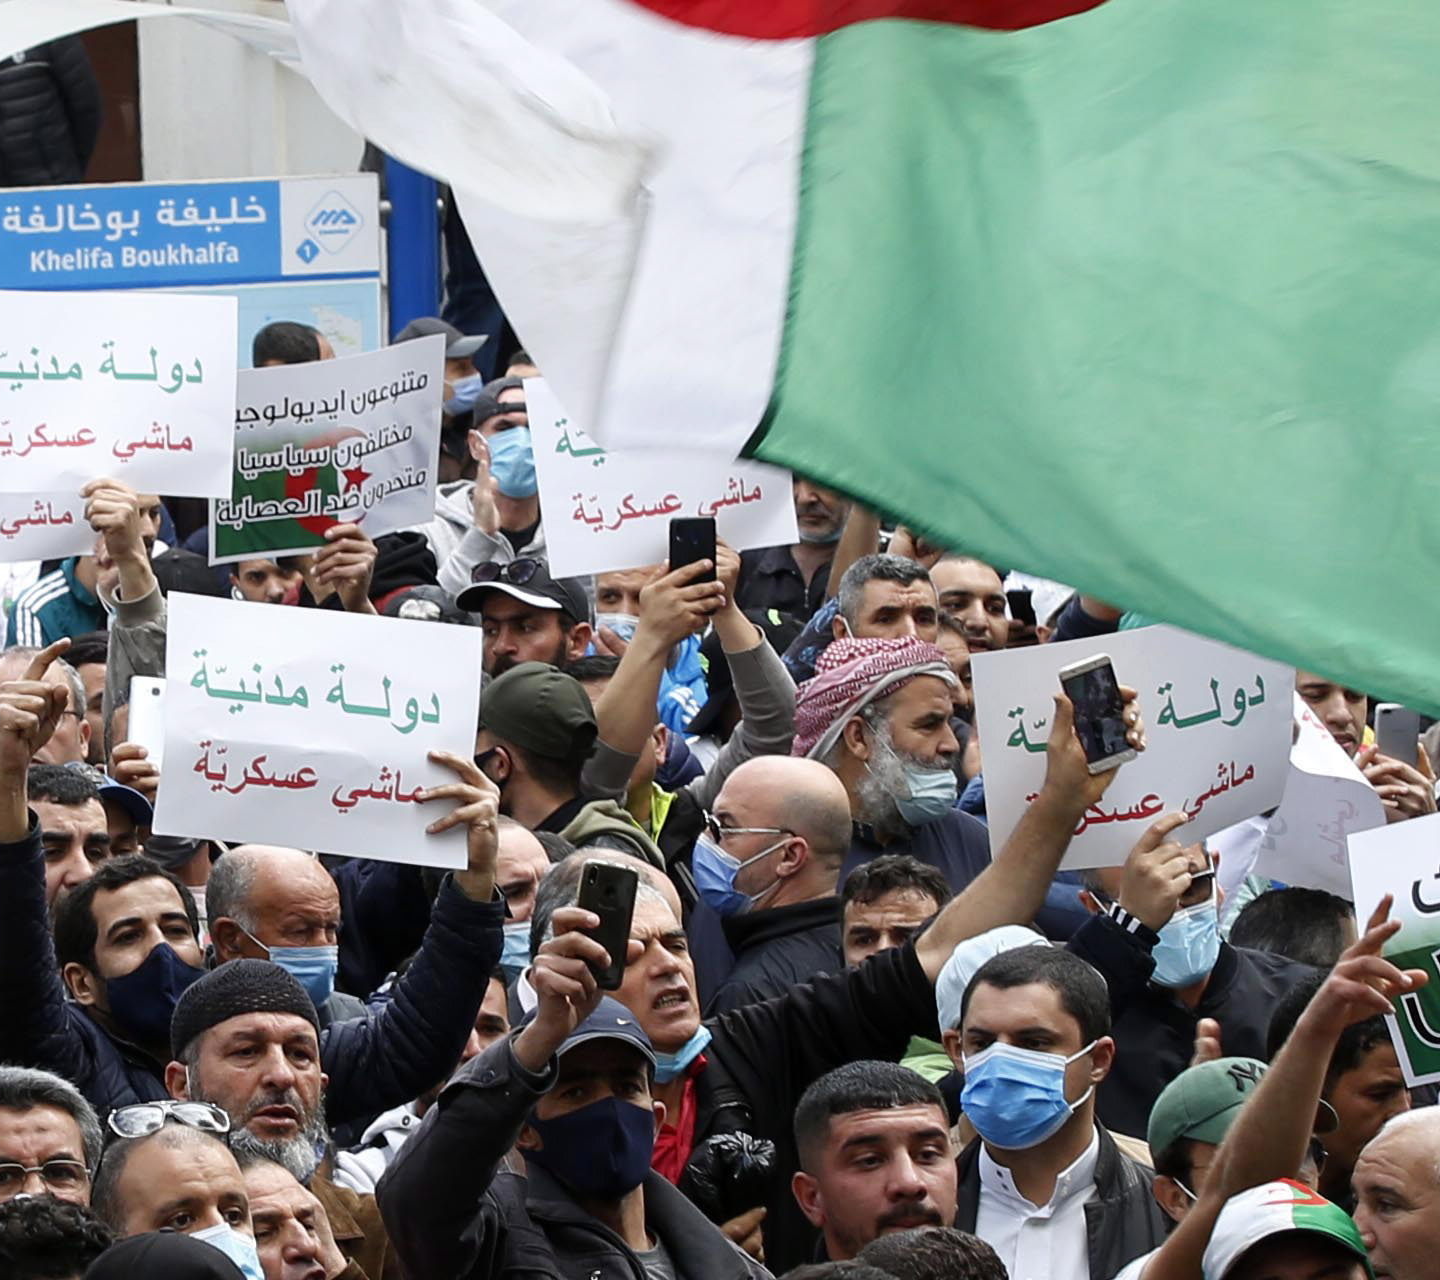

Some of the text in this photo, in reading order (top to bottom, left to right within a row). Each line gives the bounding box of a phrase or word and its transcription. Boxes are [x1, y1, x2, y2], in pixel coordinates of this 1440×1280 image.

[2, 196, 267, 241] خليفة بوخالفة
[30, 239, 240, 272] Khelifa Boukhalfa
[98, 340, 204, 393] دولة
[236, 370, 428, 429] متنوعون ايديولوجي
[112, 421, 193, 462] ماشي
[239, 423, 414, 478] مختلفون سياسيا
[0, 500, 73, 539] ماشي
[218, 466, 427, 529] متحدون ضد العصابة
[698, 477, 762, 516] ماشي
[190, 648, 441, 735] دولة مدنيّة
[1156, 674, 1266, 728] دولة
[330, 766, 424, 814] ماشي
